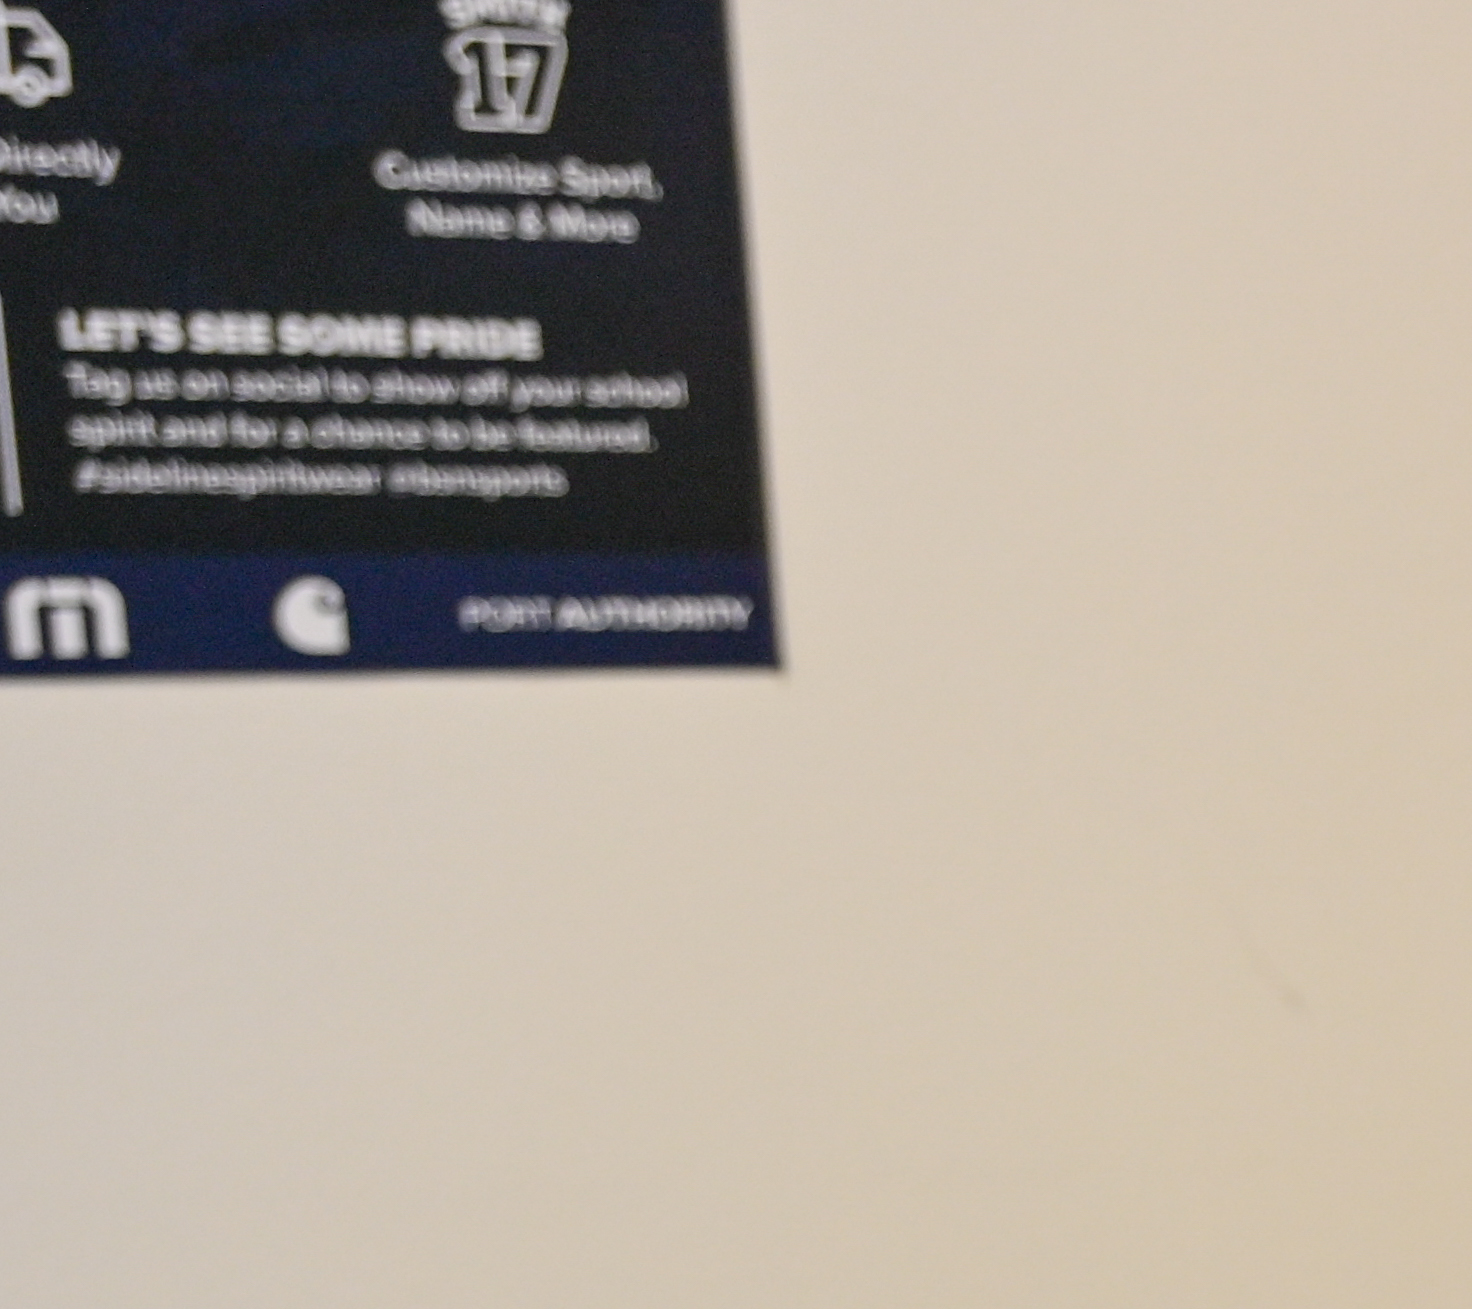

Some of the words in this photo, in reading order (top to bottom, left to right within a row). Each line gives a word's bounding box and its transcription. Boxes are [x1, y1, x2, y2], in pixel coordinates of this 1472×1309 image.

[372, 150, 557, 196] Customize
[406, 199, 515, 240] Name
[516, 201, 547, 241] &
[548, 203, 641, 245] More
[57, 306, 186, 354] LET'S
[186, 309, 275, 355] SEE
[277, 312, 408, 358] SOME
[409, 313, 544, 361] PRIDE
[63, 360, 131, 406] Tag
[133, 368, 180, 401] us
[180, 369, 230, 401] on
[230, 366, 329, 402] social
[329, 367, 370, 403] to
[370, 367, 459, 404] show
[460, 368, 511, 406] off
[509, 375, 582, 413] your
[582, 371, 688, 409] school
[66, 408, 156, 450] spirit
[158, 411, 228, 449] and
[228, 411, 279, 449] for
[281, 417, 309, 449] a
[309, 412, 431, 451] chance
[431, 416, 469, 450] to
[470, 414, 519, 451] be
[458, 596, 552, 632] PORT
[553, 594, 754, 633] AUTHORITY
